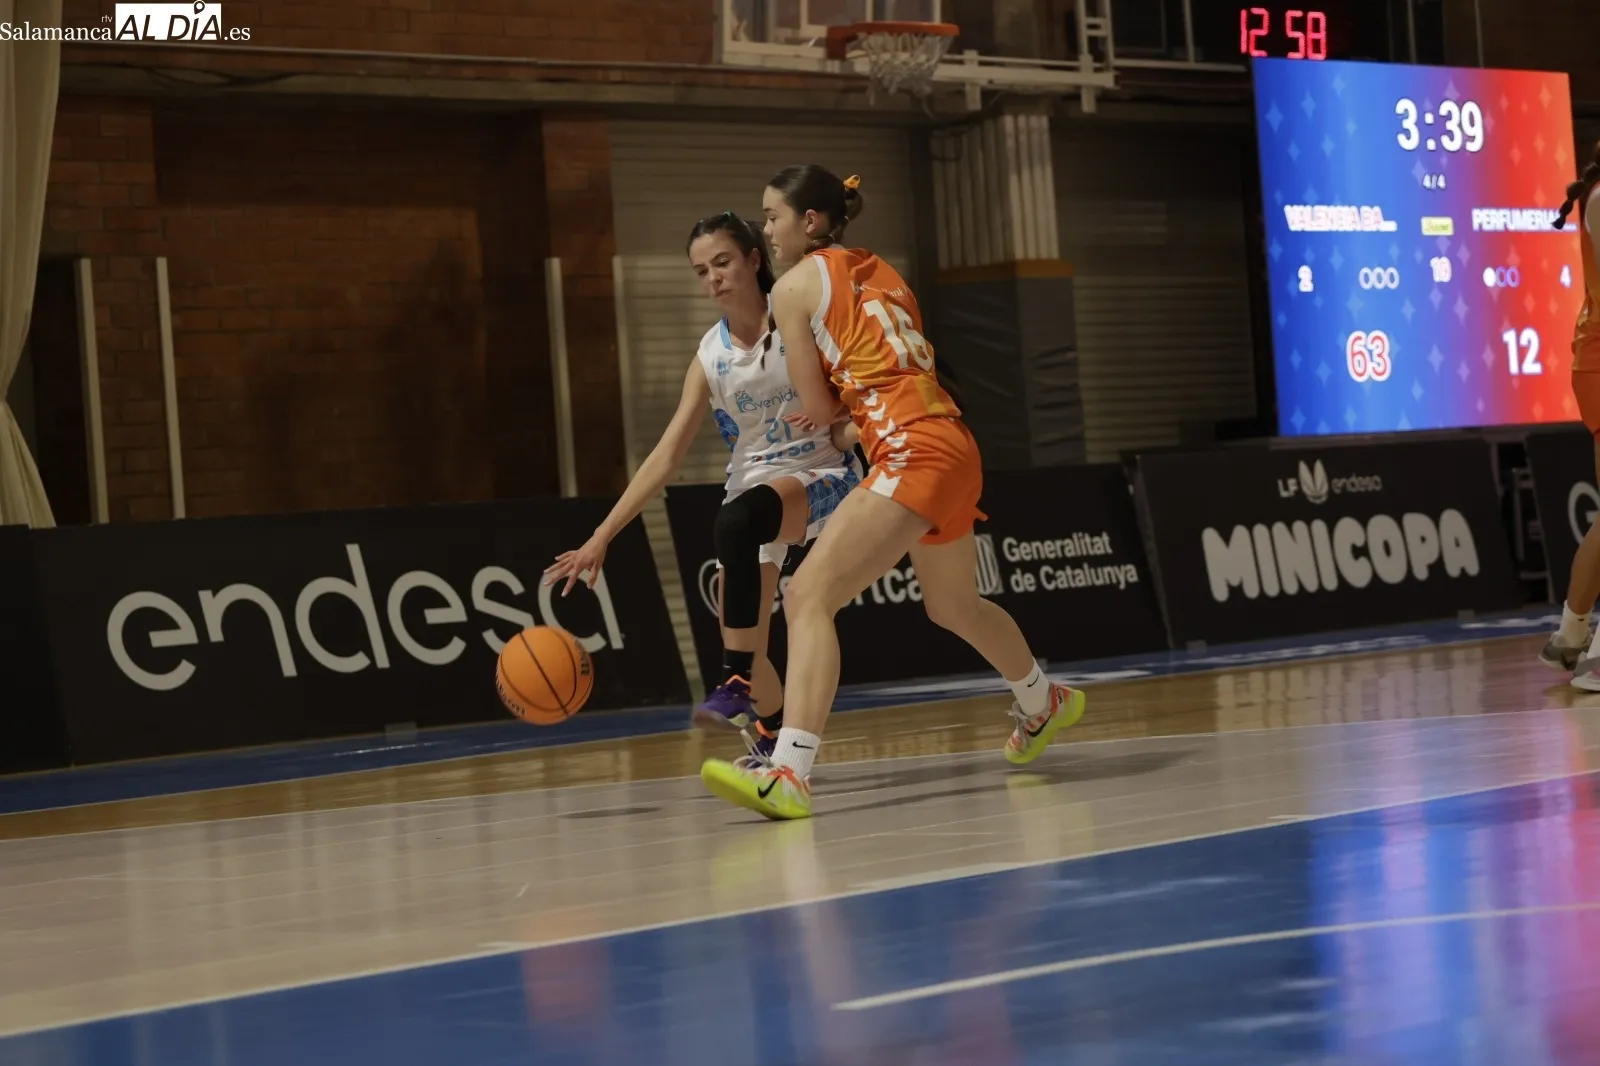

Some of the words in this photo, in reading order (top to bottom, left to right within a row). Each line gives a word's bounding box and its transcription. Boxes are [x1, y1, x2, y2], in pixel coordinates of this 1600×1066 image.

[1240, 8, 1269, 57] 12
[1286, 10, 1326, 60] 58
[1395, 98, 1485, 152] 3:39
[1560, 264, 1572, 288] 4
[1347, 330, 1392, 382] 63
[1503, 327, 1543, 376] 12
[1277, 478, 1299, 498] LF
[1002, 531, 1113, 563] Generalitat
[1202, 508, 1480, 602] MINICOPA
[1010, 567, 1037, 594] de
[1039, 562, 1139, 590] Catalunya
[107, 543, 624, 691] endesa
